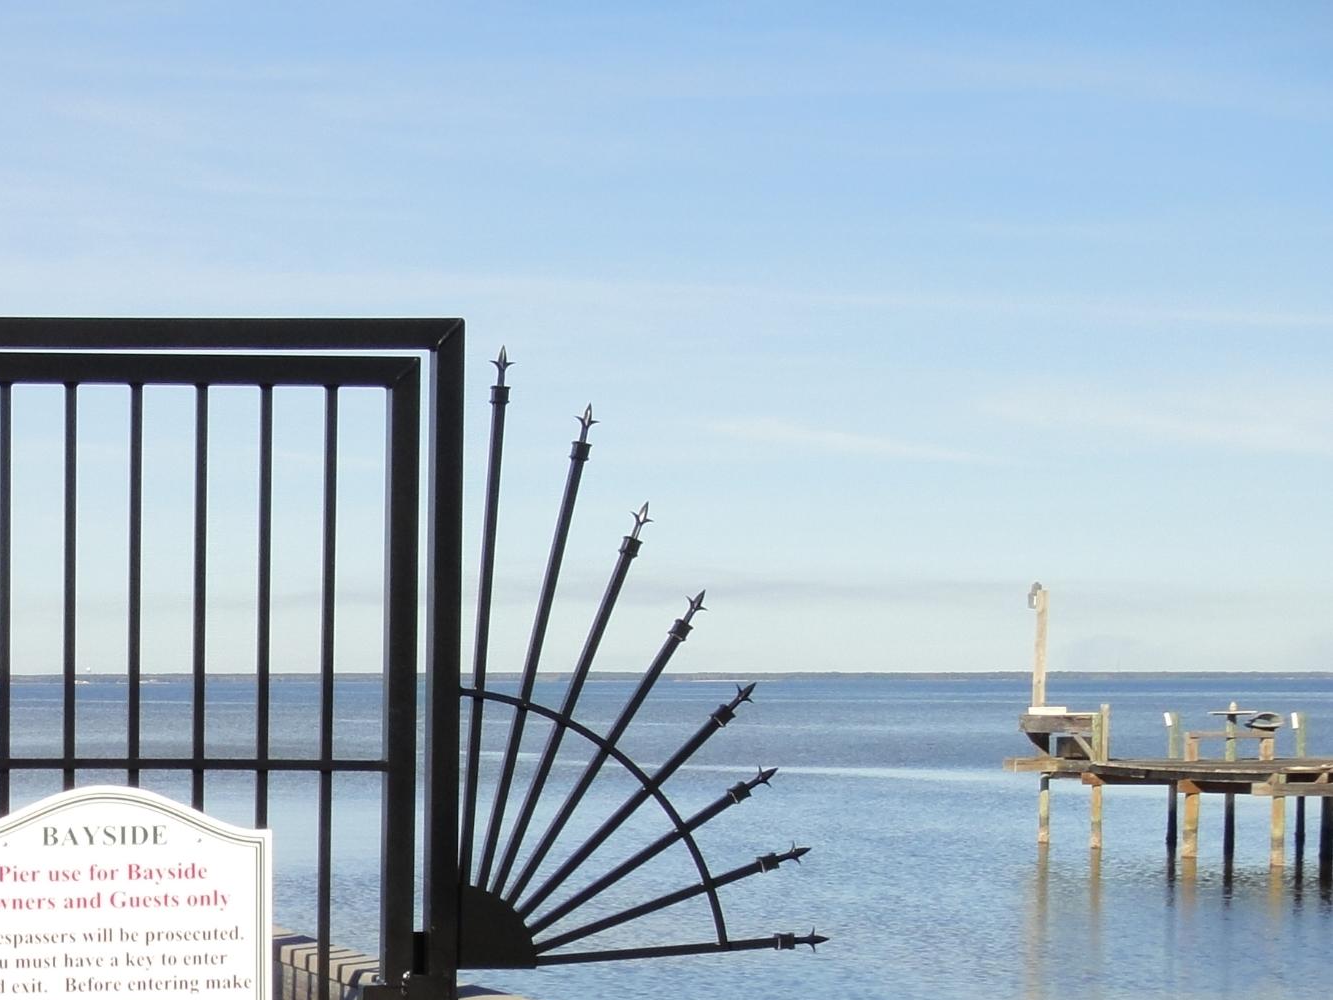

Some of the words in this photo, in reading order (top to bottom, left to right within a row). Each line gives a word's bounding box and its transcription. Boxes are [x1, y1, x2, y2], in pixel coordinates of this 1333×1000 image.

[42, 825, 168, 846] BAYSIDE
[48, 867, 81, 882] use
[90, 864, 119, 882] for
[128, 863, 208, 885] Bayside
[64, 893, 101, 909] and
[110, 892, 179, 909] Guests
[187, 890, 230, 911] only
[83, 928, 113, 942] will
[120, 928, 139, 942] be
[146, 927, 244, 945] prosecuted.
[16, 955, 56, 969] must
[64, 954, 103, 968] have
[110, 957, 118, 967] a
[126, 953, 154, 971] key
[162, 953, 176, 966] to
[184, 952, 227, 966] enter
[12, 980, 47, 994] exit.
[66, 978, 121, 992] Before
[128, 977, 199, 993] entering
[206, 975, 252, 989] make
